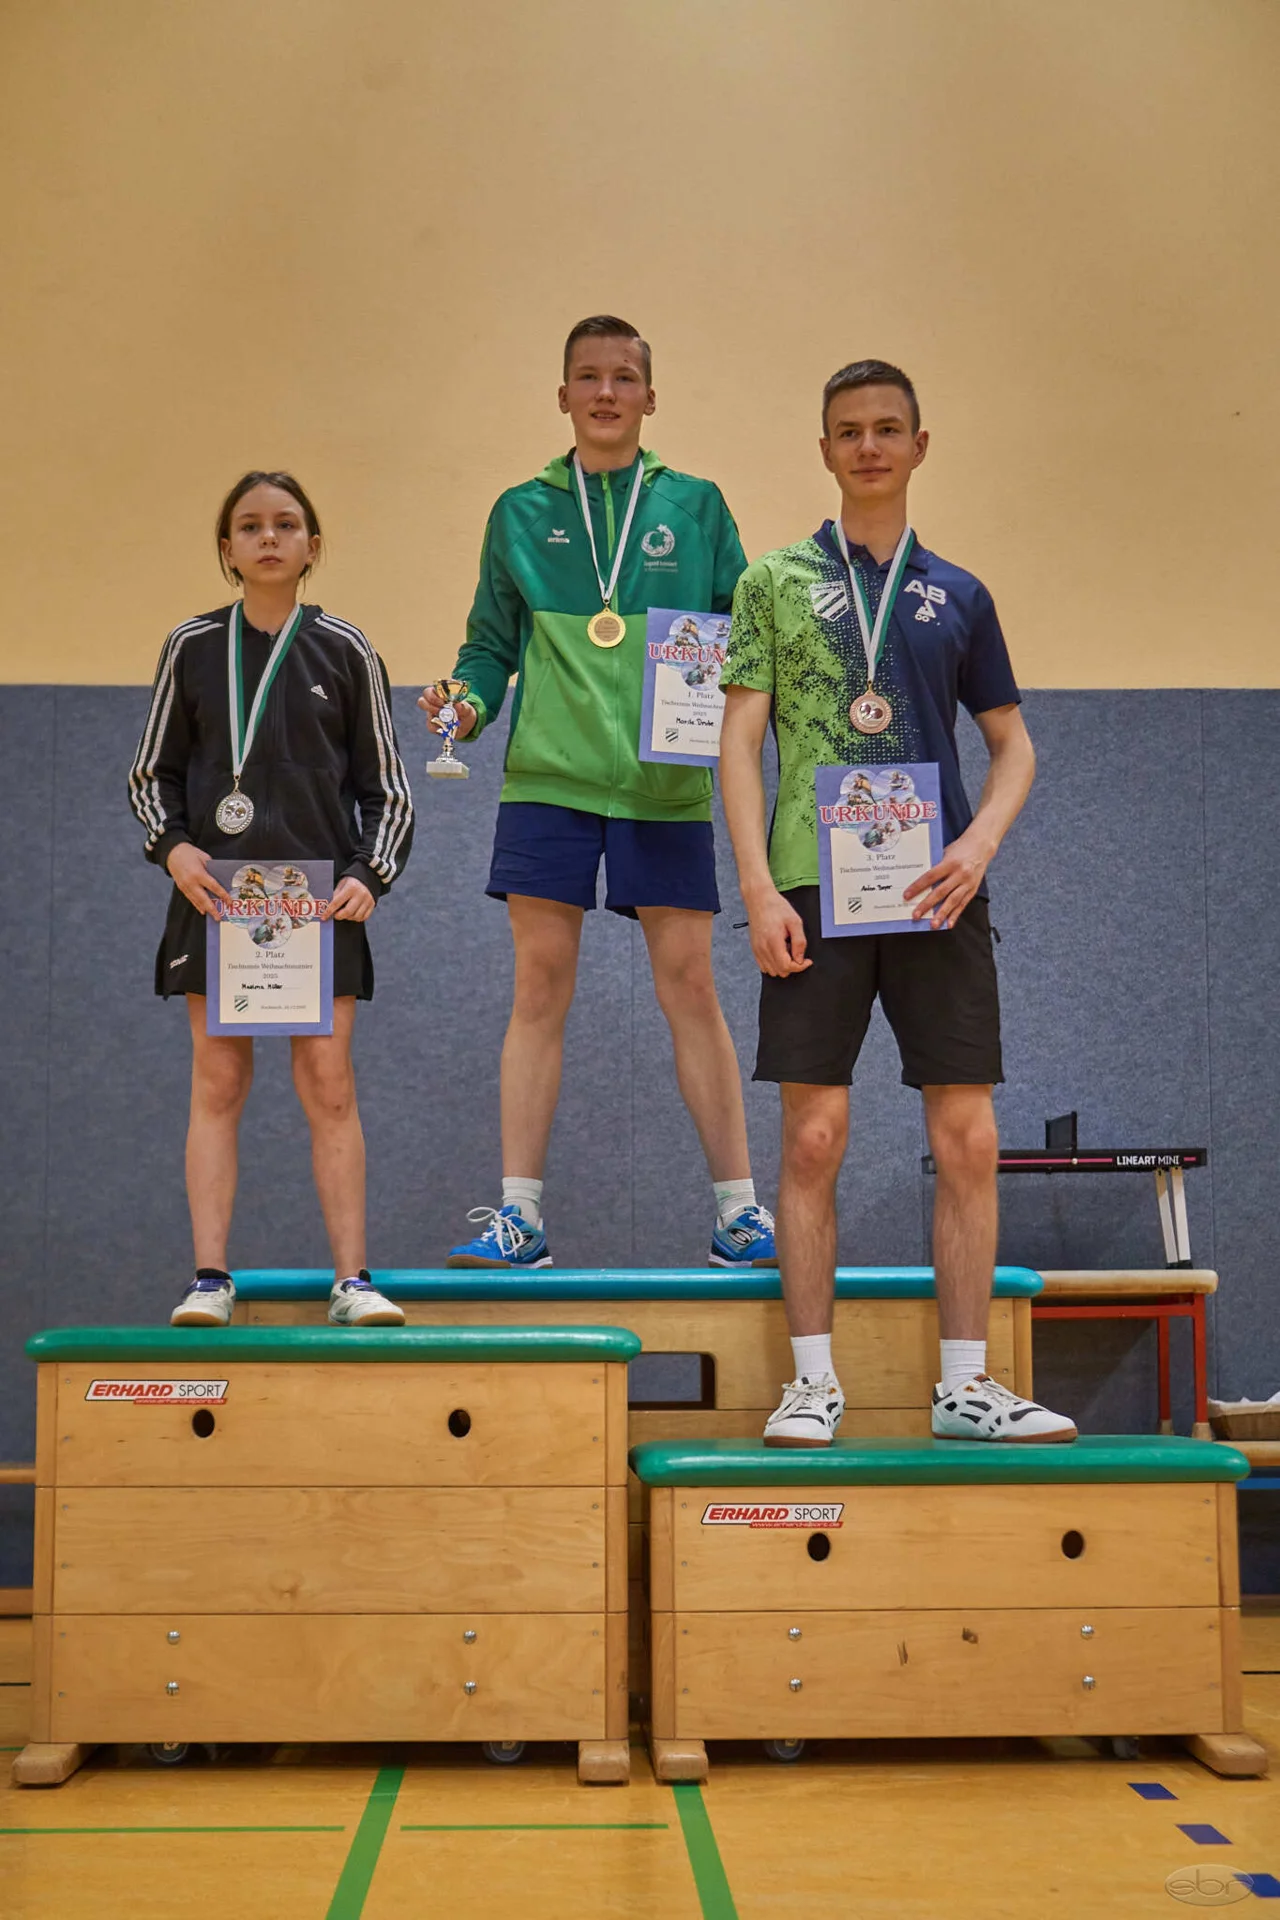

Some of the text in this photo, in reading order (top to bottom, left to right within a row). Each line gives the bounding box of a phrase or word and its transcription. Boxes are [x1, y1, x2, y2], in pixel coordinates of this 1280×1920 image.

[648, 643, 726, 665] URKUN
[819, 801, 937, 823] URKUNDE
[1116, 1155, 1180, 1166] LINEART MINI
[92, 1384, 222, 1397] ERHARD SPORT
[708, 1507, 837, 1521] ERHARD SPORT
